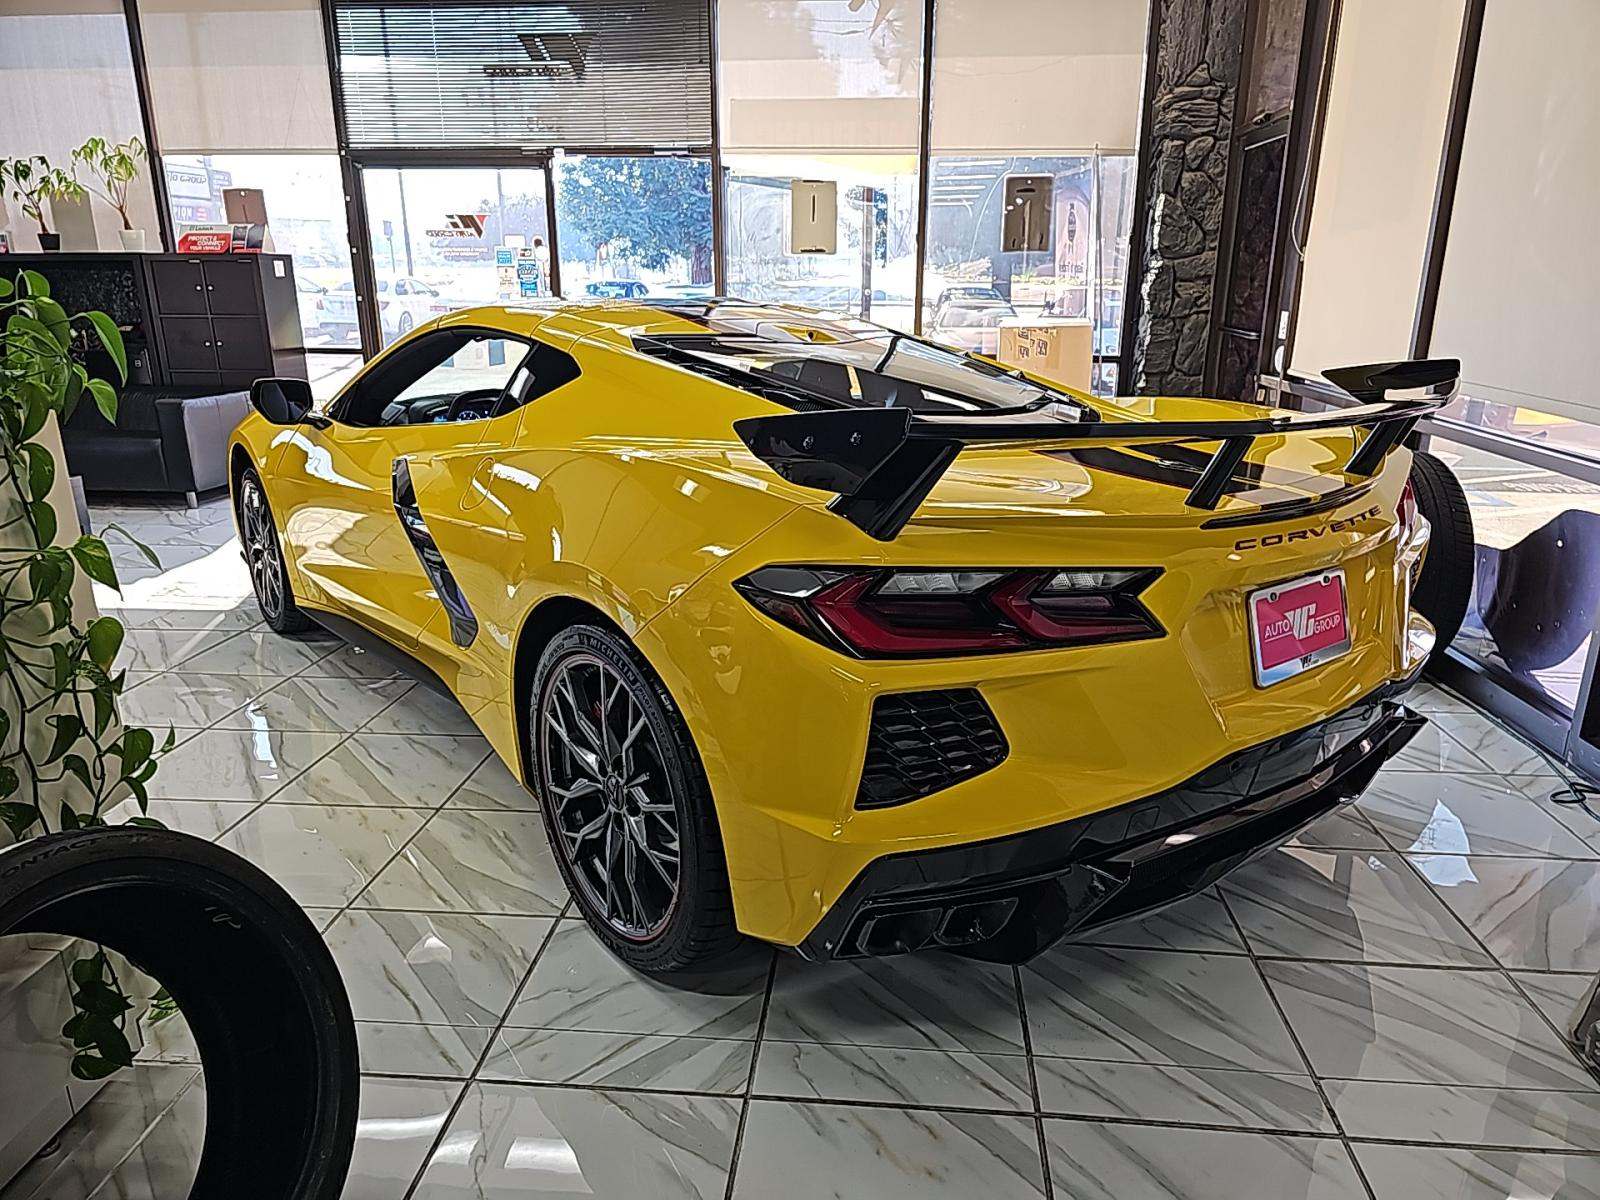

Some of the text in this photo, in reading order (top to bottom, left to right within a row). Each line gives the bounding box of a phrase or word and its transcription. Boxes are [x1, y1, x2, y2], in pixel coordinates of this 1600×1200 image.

[1234, 504, 1382, 551] CORVETTE
[1264, 617, 1291, 639] AUTO
[1313, 614, 1341, 634] GROUP
[589, 637, 636, 683] MICHELIN
